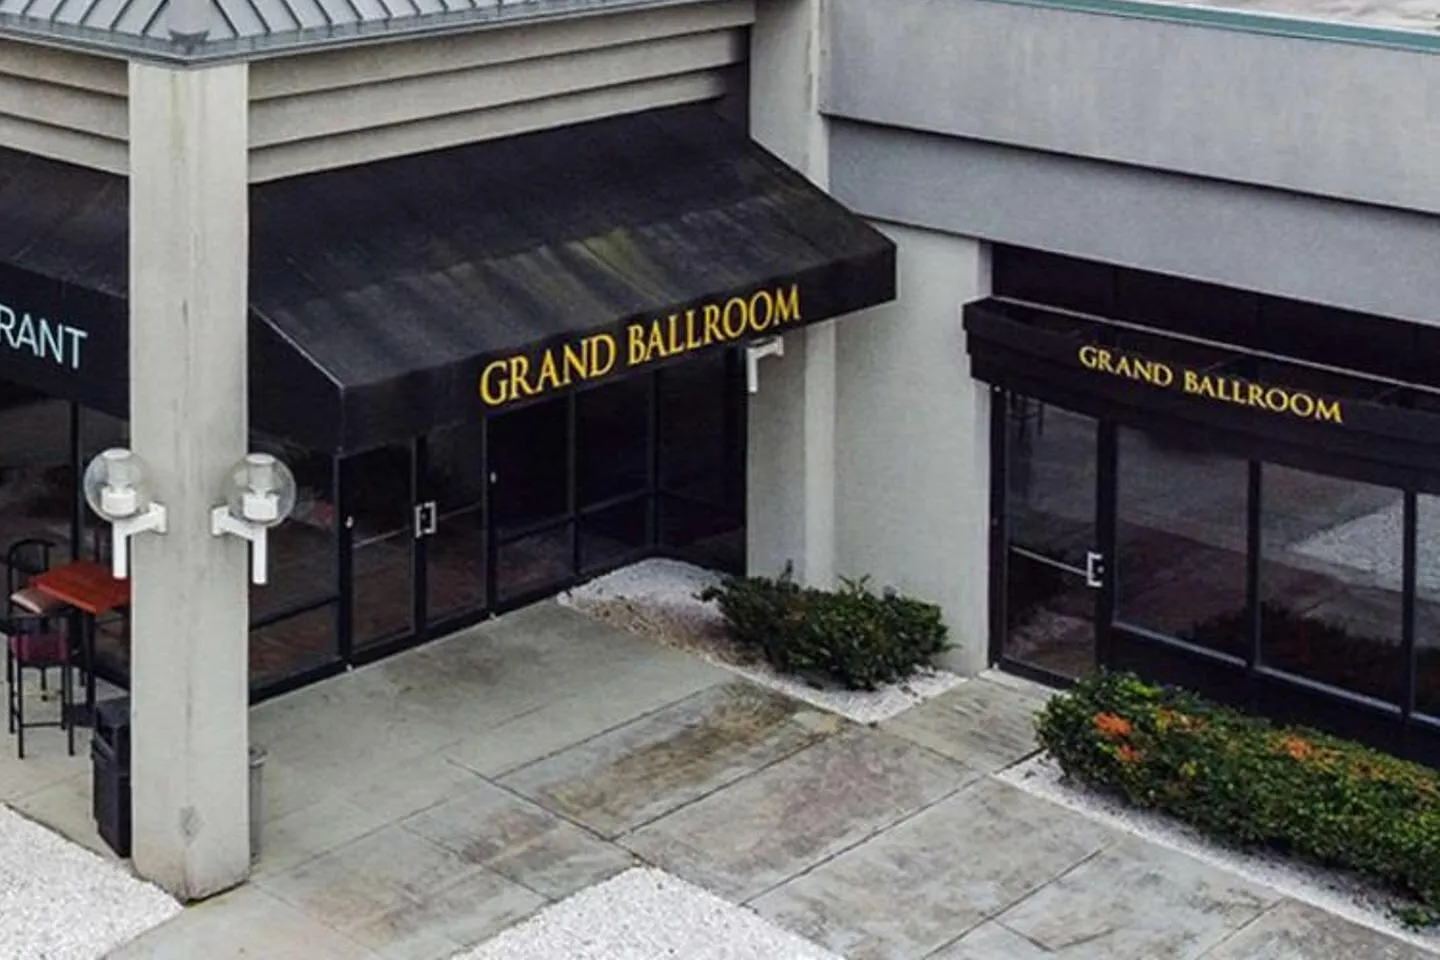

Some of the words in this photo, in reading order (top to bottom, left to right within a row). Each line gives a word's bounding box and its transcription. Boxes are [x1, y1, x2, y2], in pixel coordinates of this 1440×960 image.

[480, 334, 616, 406] GRAND
[626, 284, 801, 365] BALLROOM
[1079, 345, 1173, 386] GRAND
[1183, 370, 1342, 423] BALLROOM
